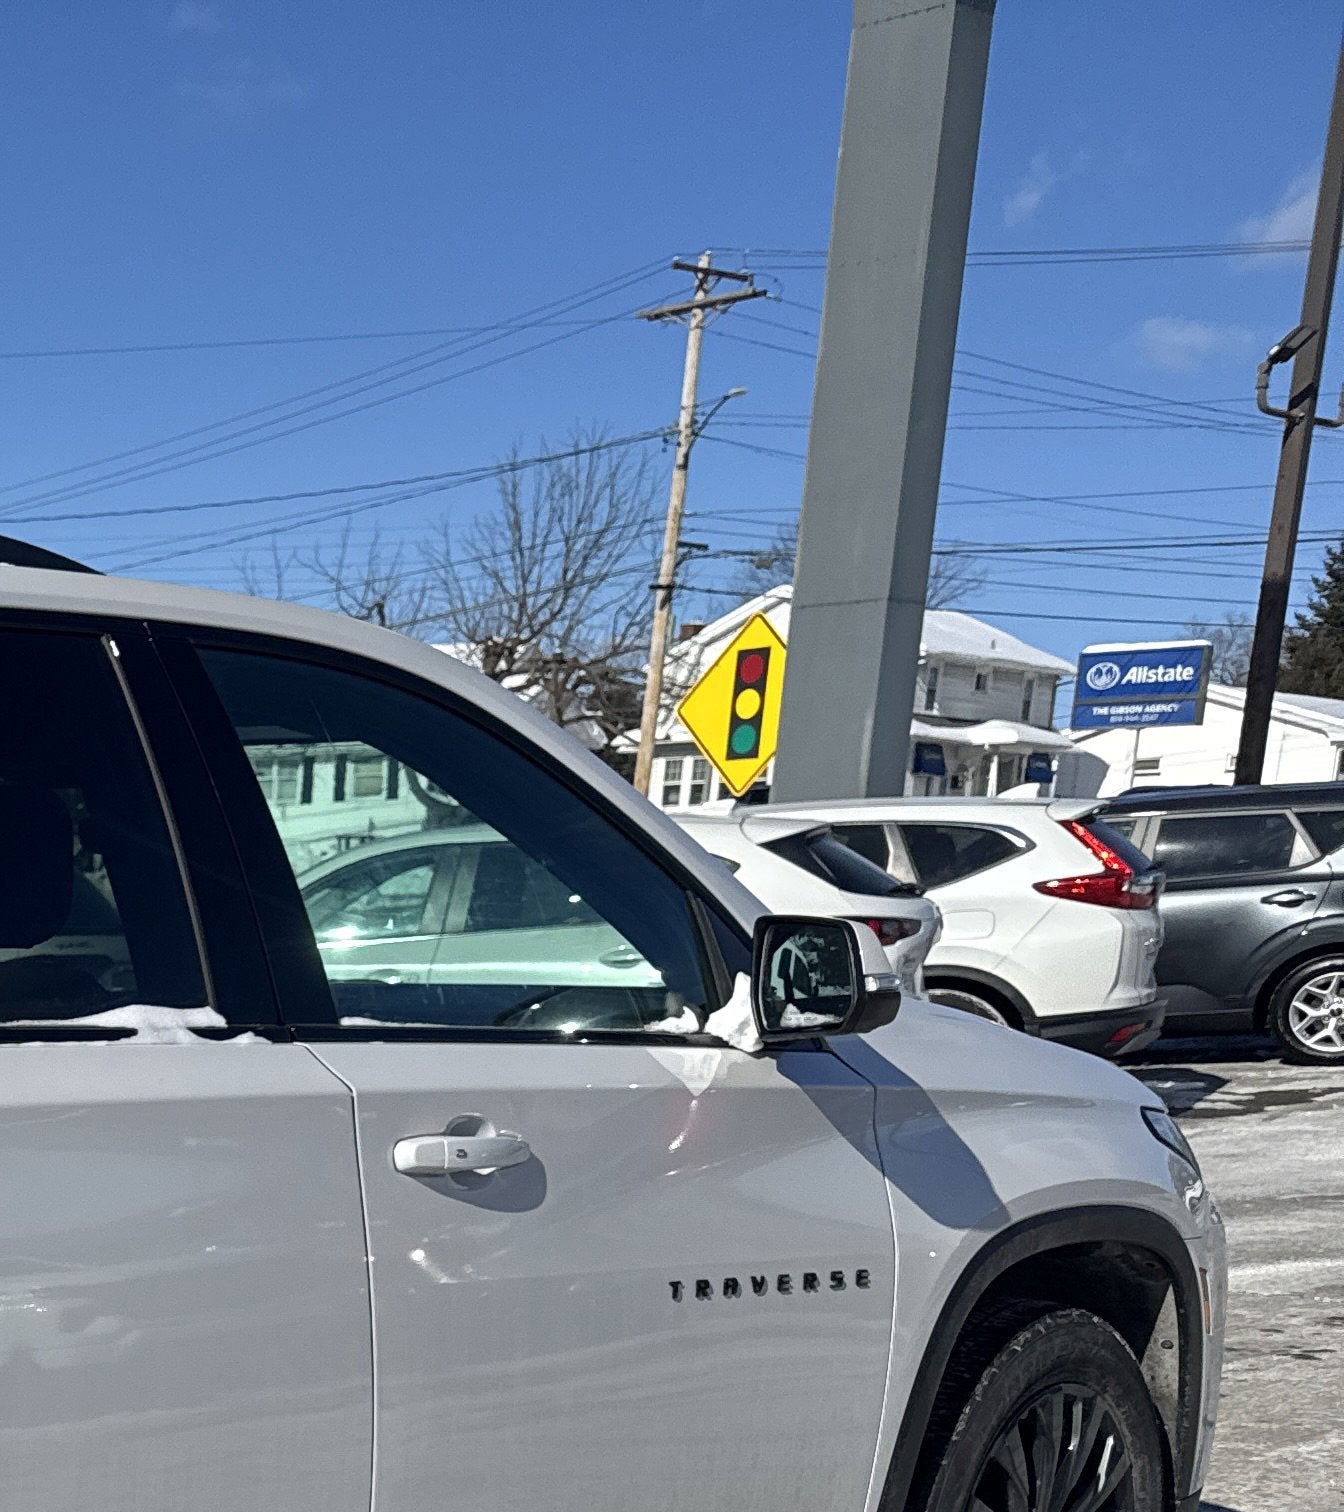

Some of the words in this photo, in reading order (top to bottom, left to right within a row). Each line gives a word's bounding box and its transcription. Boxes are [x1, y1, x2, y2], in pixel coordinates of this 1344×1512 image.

[1120, 664, 1194, 685] Allstate
[1093, 705, 1109, 716] THE
[1143, 702, 1180, 713] AGENCY
[669, 1269, 872, 1303] TRAVERSE
